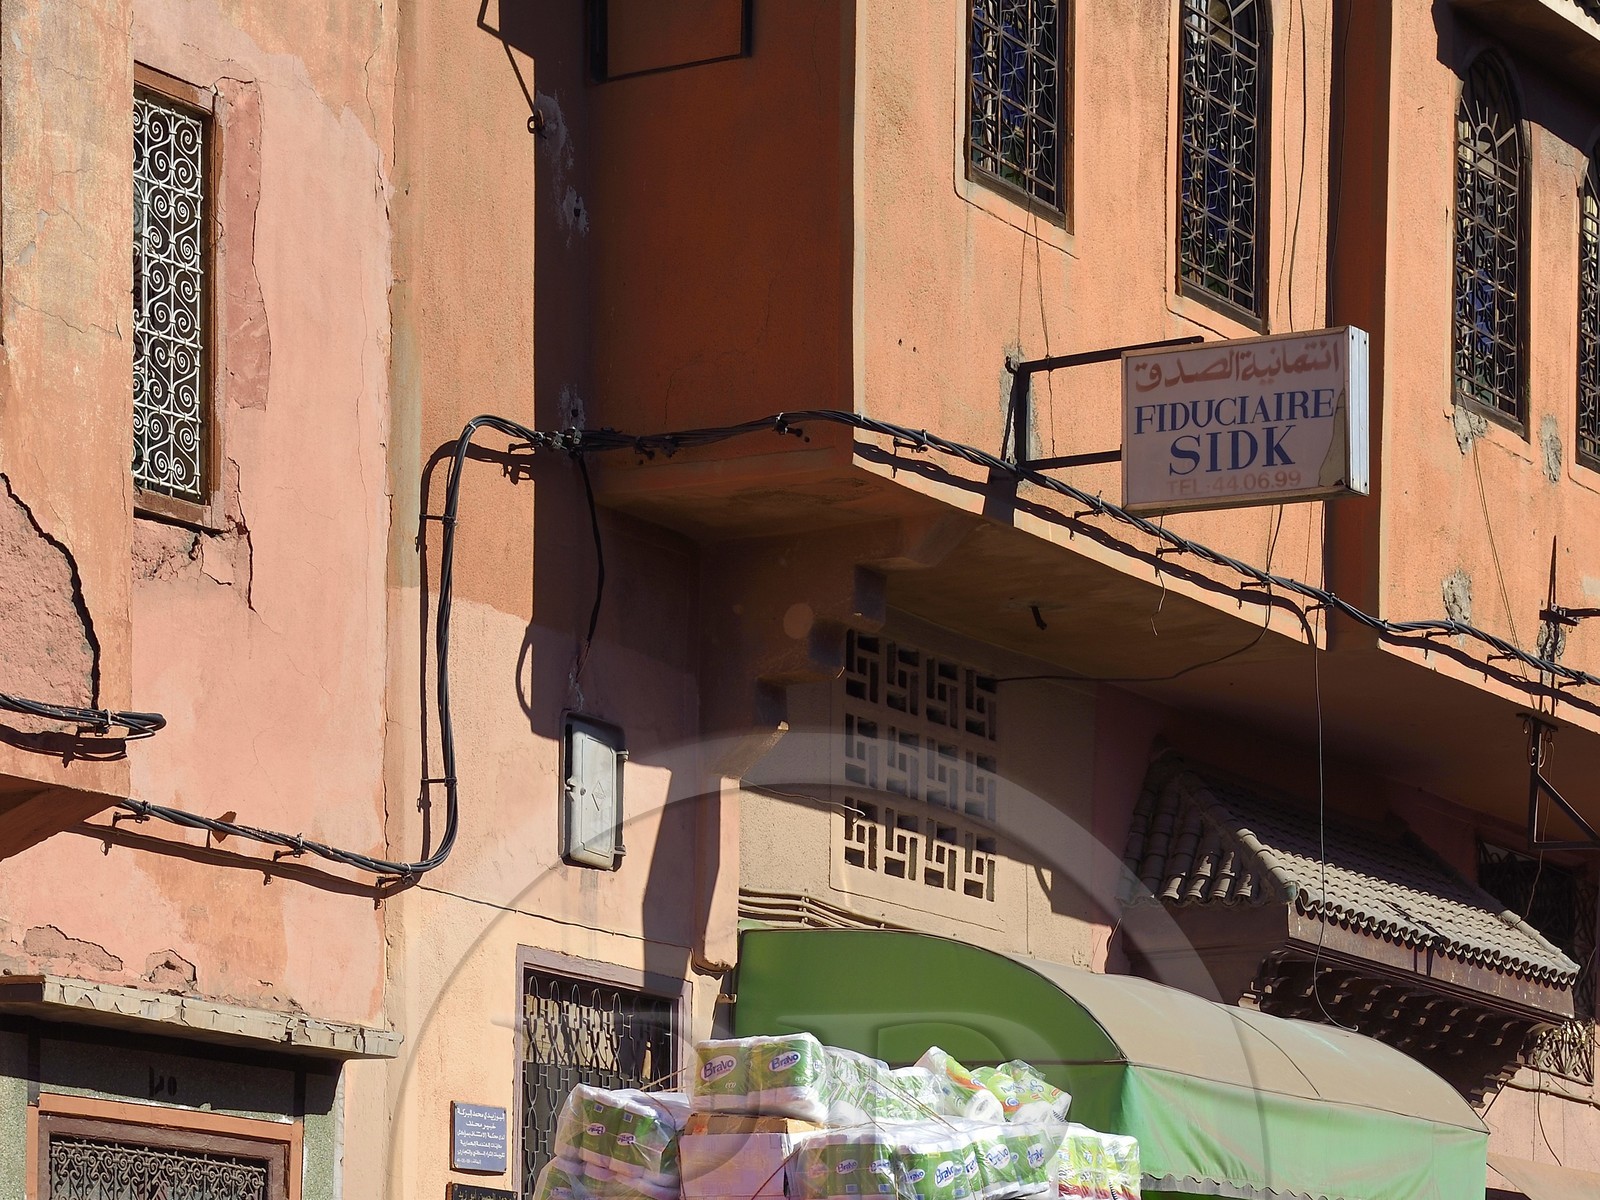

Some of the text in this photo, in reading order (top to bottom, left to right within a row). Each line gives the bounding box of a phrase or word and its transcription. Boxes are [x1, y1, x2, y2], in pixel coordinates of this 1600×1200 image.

[1135, 349, 1240, 393] الصدق
[1134, 388, 1335, 435] FIDUCIAIRE
[1169, 425, 1296, 476] SIDK
[703, 1058, 734, 1079] Bravo
[771, 1052, 799, 1070] Bravo
[837, 1160, 857, 1173] Bravo
